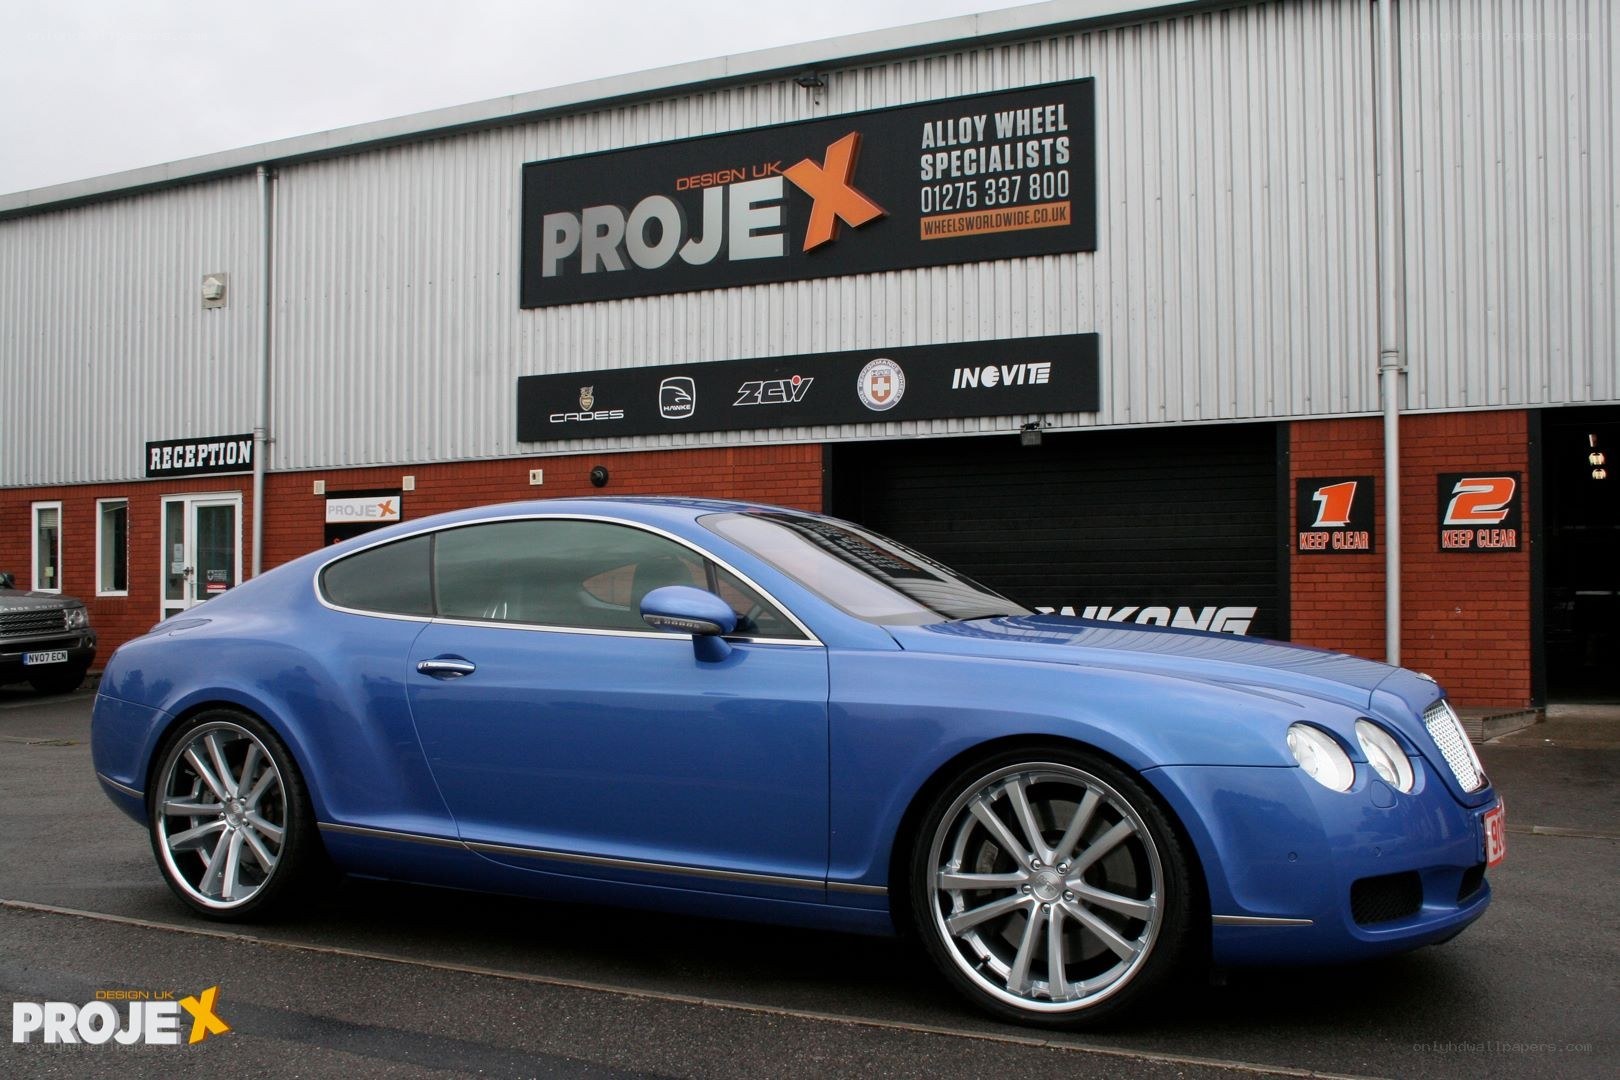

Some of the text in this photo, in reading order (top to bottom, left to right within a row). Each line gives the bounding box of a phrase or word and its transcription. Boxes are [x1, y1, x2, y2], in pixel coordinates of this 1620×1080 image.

[921, 103, 1068, 150] ALLOY WHEEL
[920, 136, 1070, 182] SPECIALISTS
[676, 160, 784, 192] DESIGN UK
[920, 169, 1070, 213] 01275 337 800
[541, 131, 887, 278] PROJEX
[923, 206, 1067, 236] WHEELSWORLDWIDE.CO.UK
[951, 361, 1052, 390] INOVITE
[549, 409, 625, 424] CADES
[663, 404, 692, 412] HAWKE
[150, 440, 252, 470] RECEPTION
[328, 499, 398, 518] PROJEX
[1311, 481, 1358, 528] 1
[1443, 476, 1516, 525] 2
[1299, 531, 1369, 550] KEEP CLEAR
[1441, 528, 1516, 549] KEEP CLEAR
[28, 651, 67, 664] NV07 ECN
